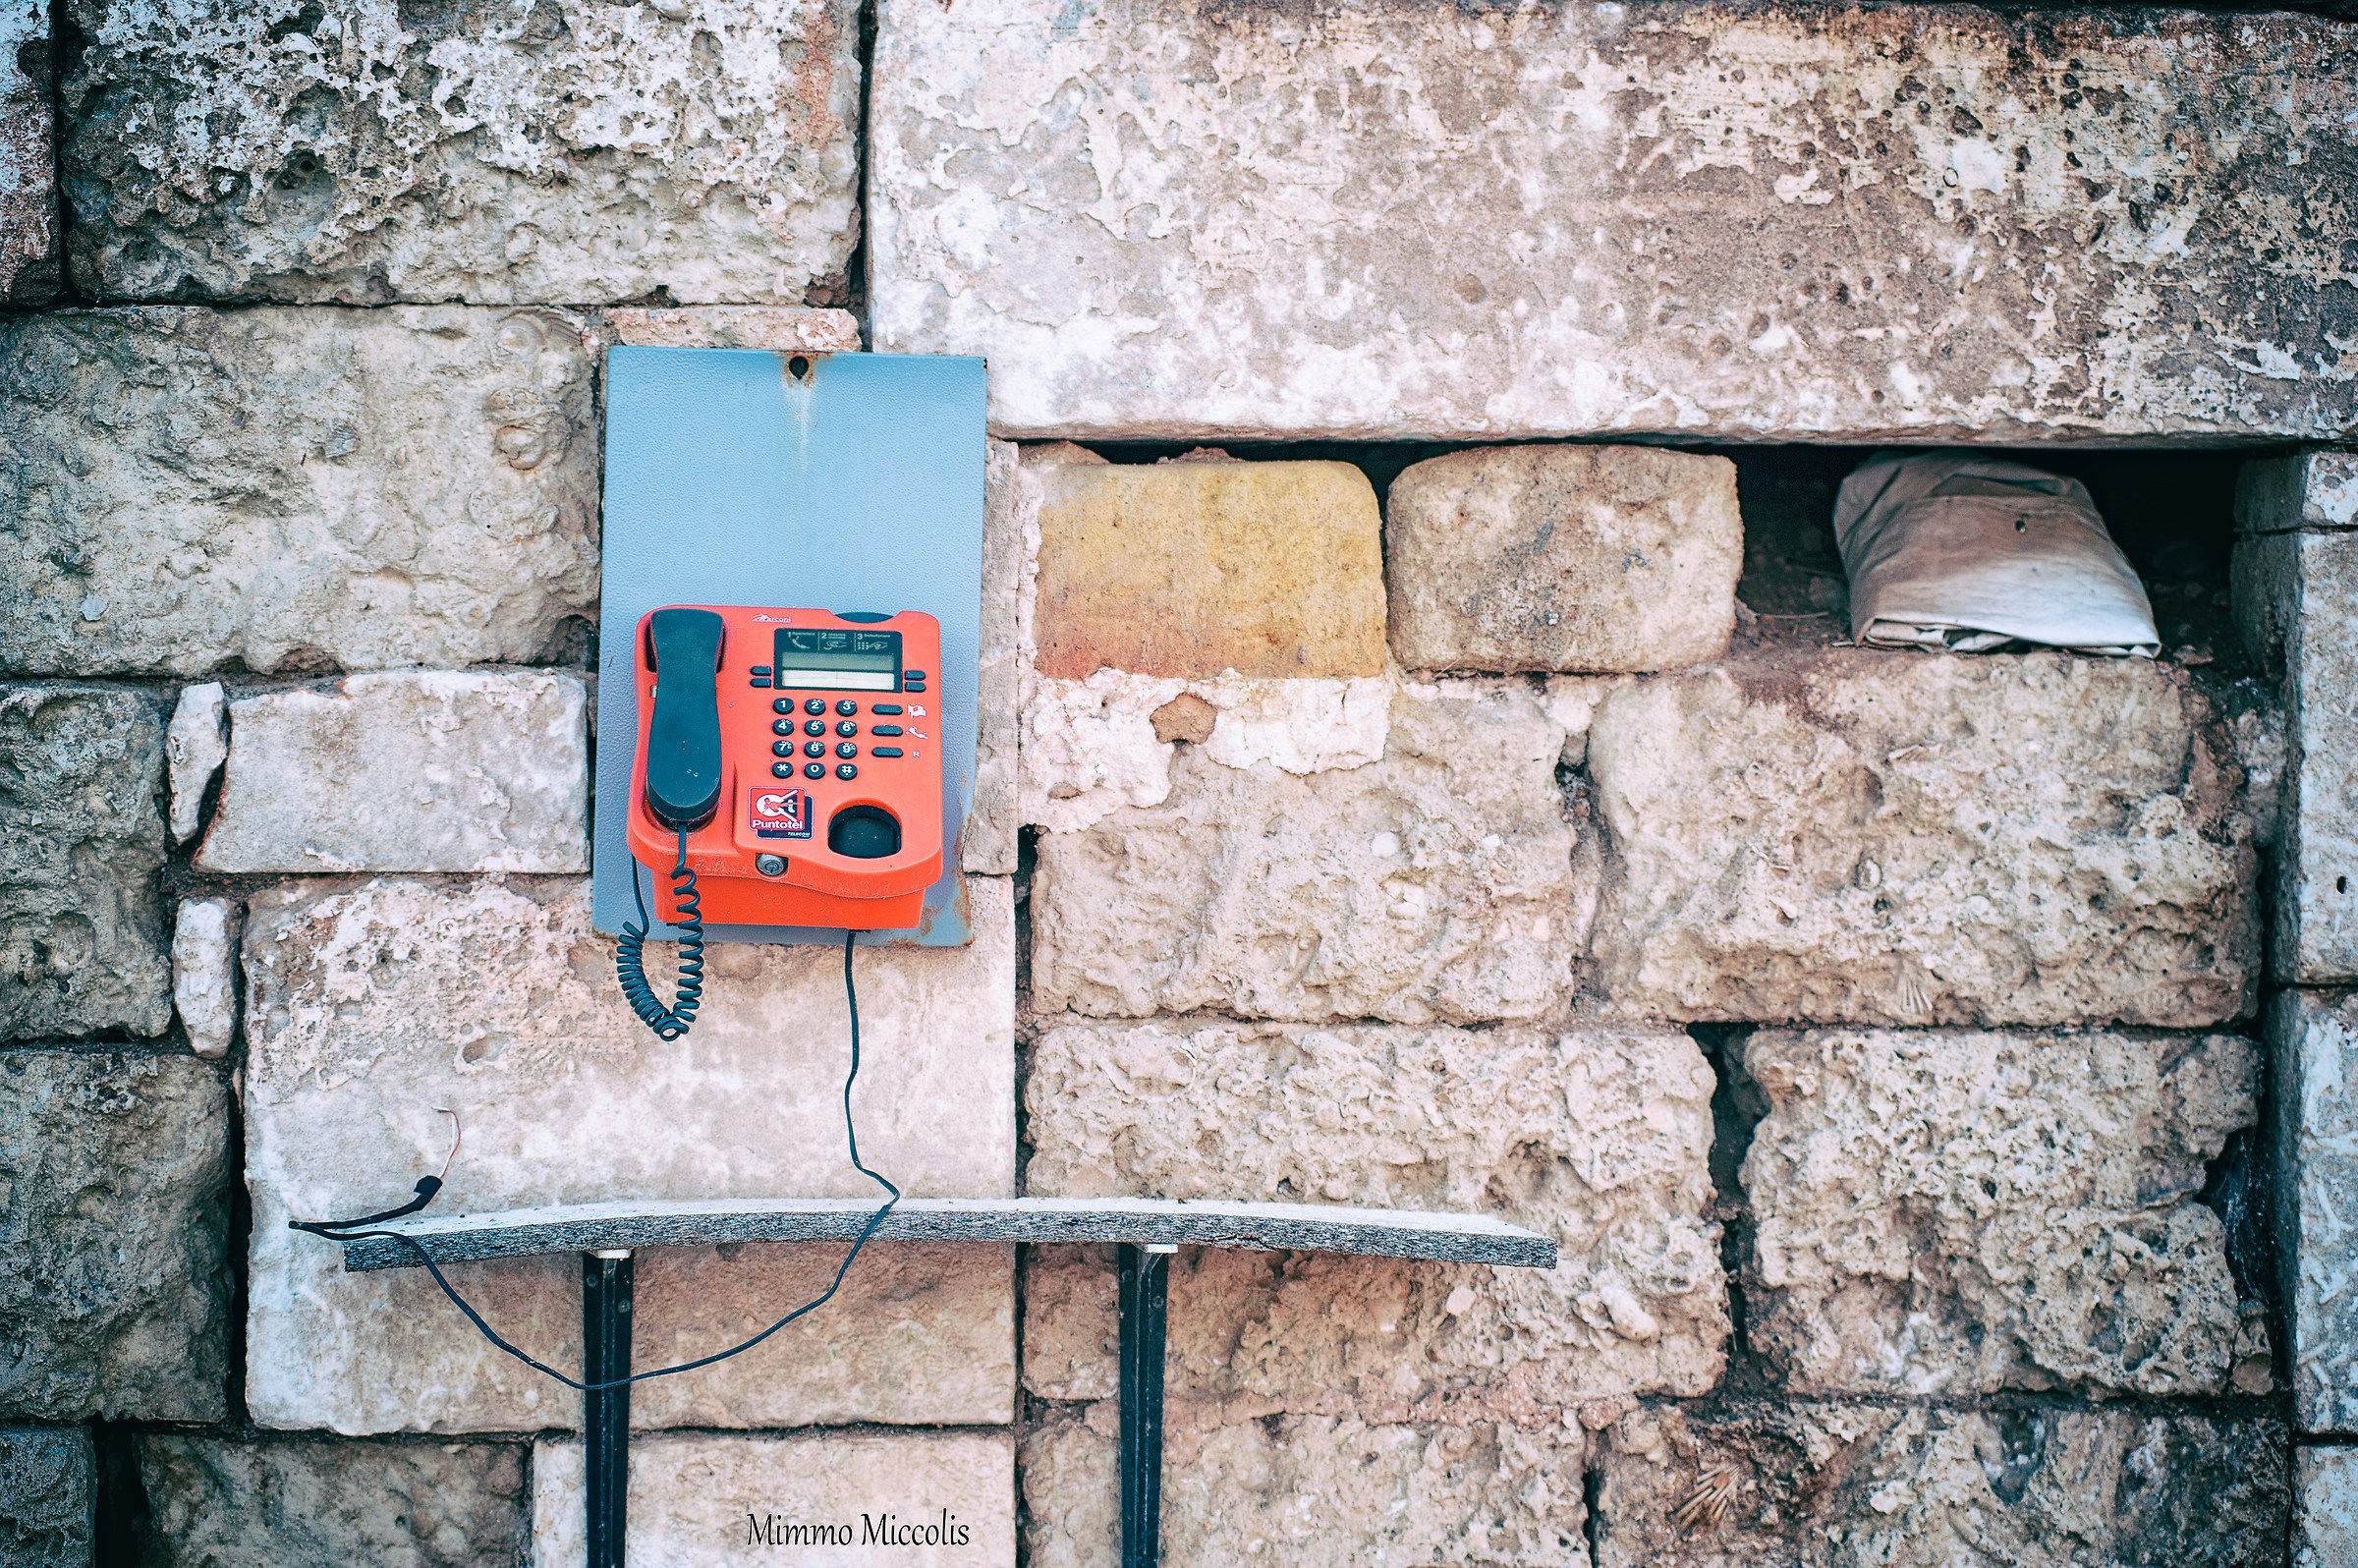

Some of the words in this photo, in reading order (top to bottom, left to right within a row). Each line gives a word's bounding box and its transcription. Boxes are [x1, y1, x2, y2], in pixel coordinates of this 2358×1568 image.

[780, 700, 786, 708] 1
[778, 743, 787, 752] 7
[811, 744, 819, 753] 8
[842, 745, 851, 754] 9
[752, 819, 803, 829] Puntotel
